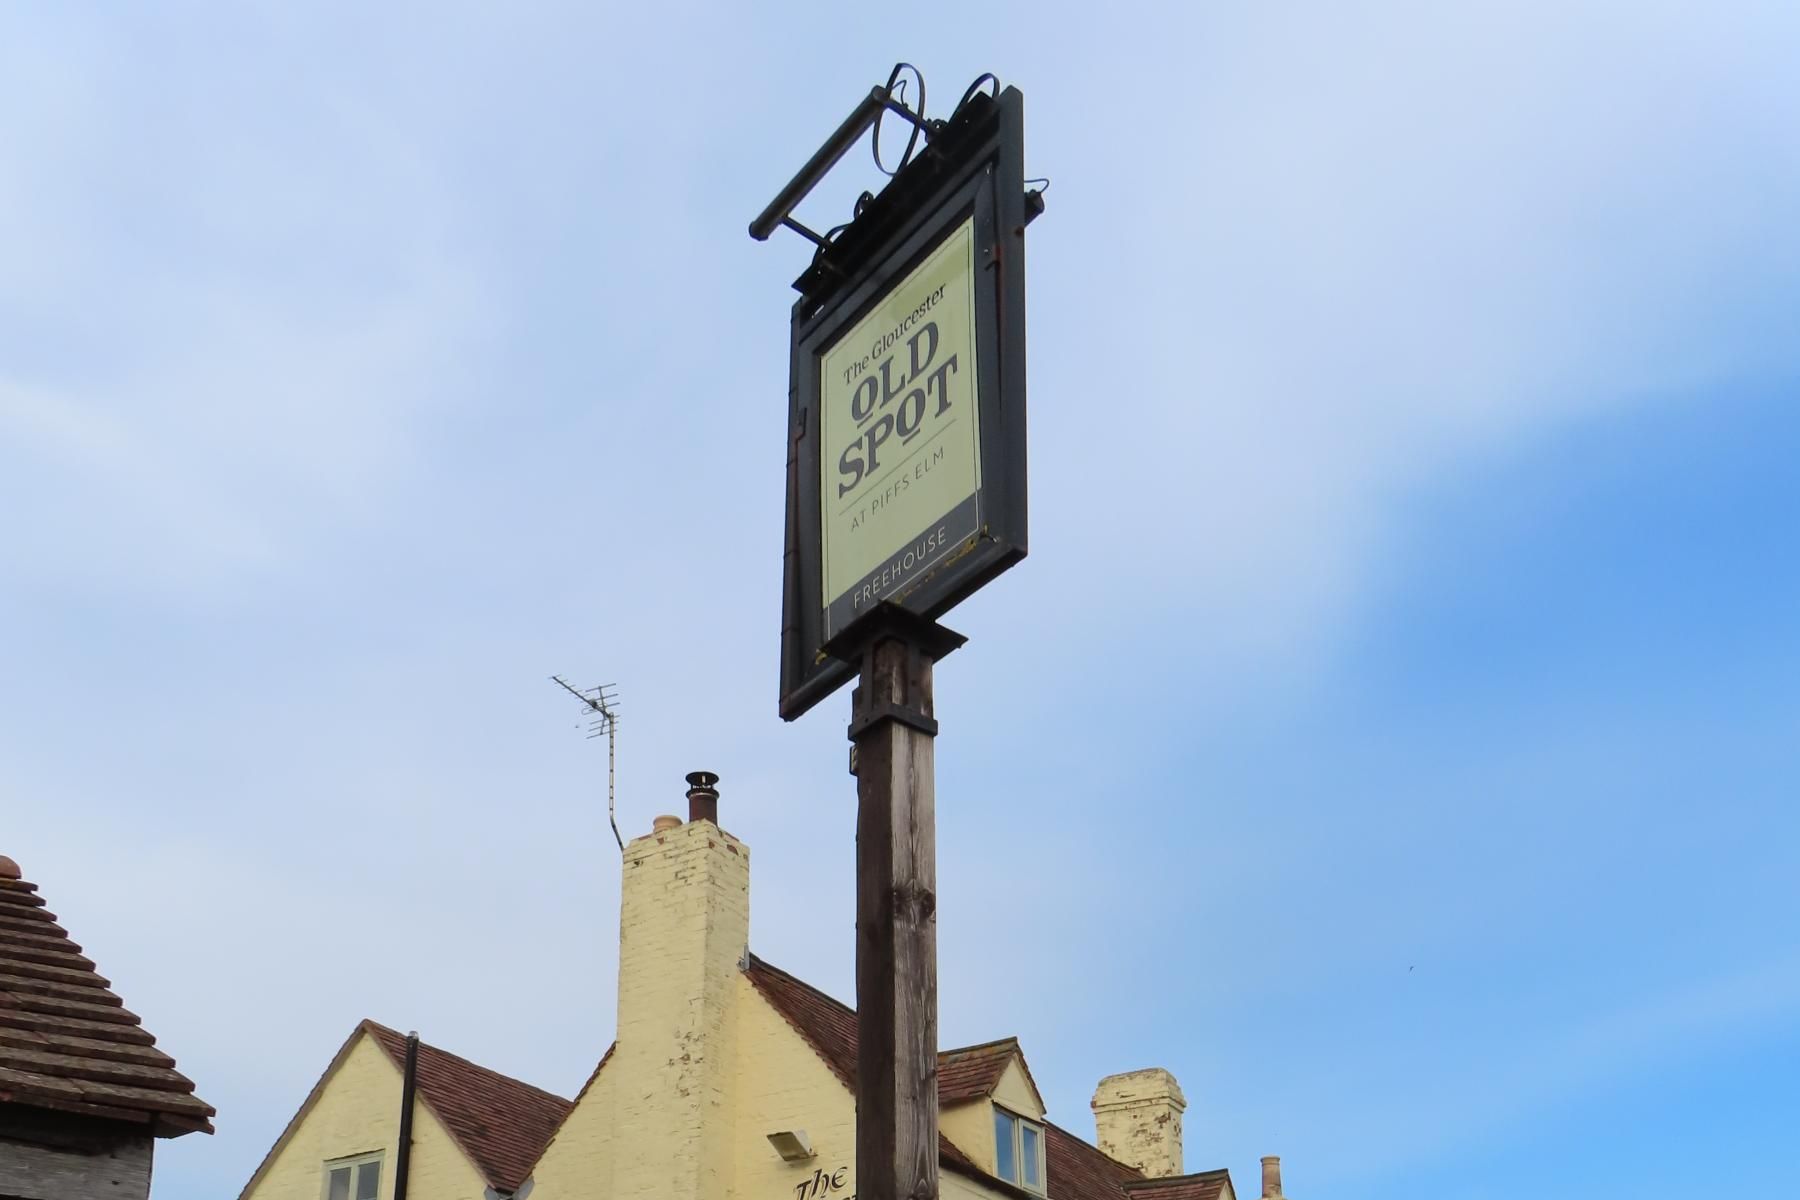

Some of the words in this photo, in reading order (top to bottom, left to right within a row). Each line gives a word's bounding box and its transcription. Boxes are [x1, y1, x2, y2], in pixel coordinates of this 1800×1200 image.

[843, 356, 870, 386] The
[872, 283, 946, 360] Gloucester
[851, 321, 939, 429] OLD
[839, 352, 958, 500] SPOT
[851, 511, 866, 533] AT
[872, 474, 910, 515] PIFFS
[914, 447, 945, 480] ELM
[853, 526, 946, 609] FREEHOUSE
